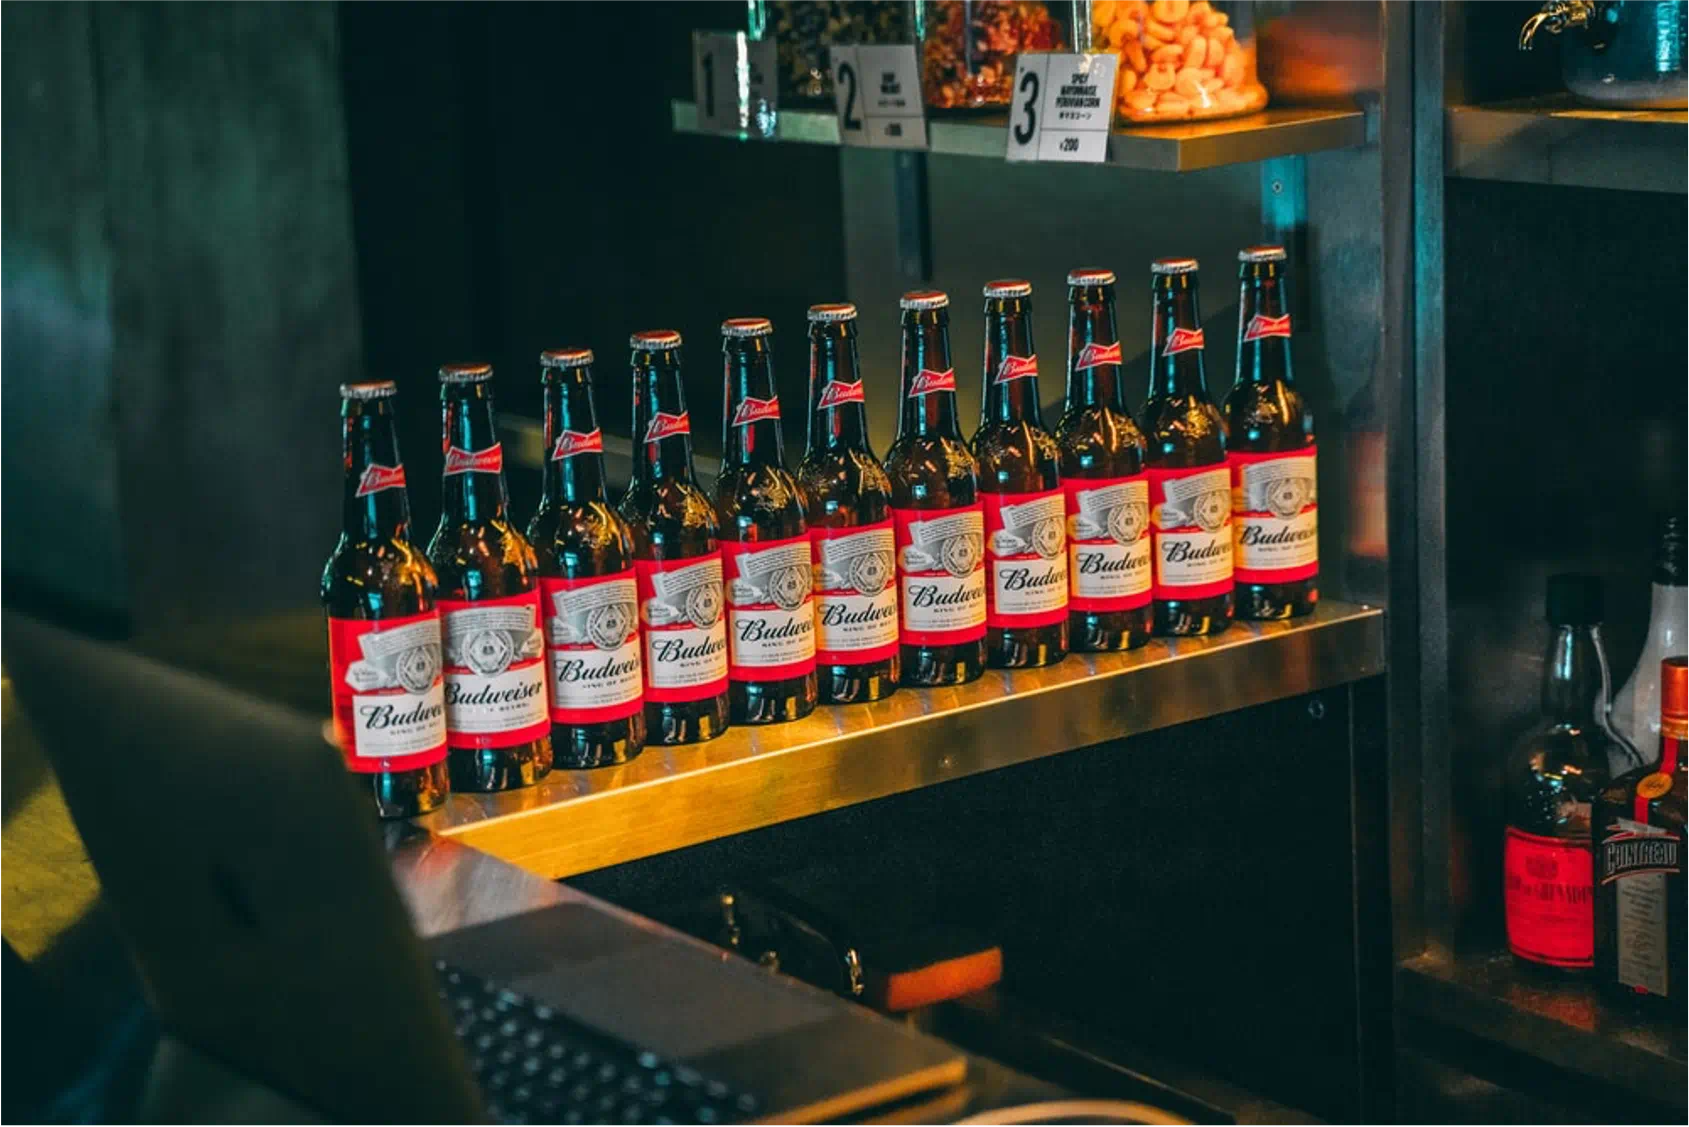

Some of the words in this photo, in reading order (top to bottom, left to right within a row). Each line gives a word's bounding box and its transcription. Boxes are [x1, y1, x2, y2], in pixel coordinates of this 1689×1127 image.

[838, 61, 861, 131] 2
[1014, 71, 1039, 146] 3
[445, 681, 542, 706] Budweiser
